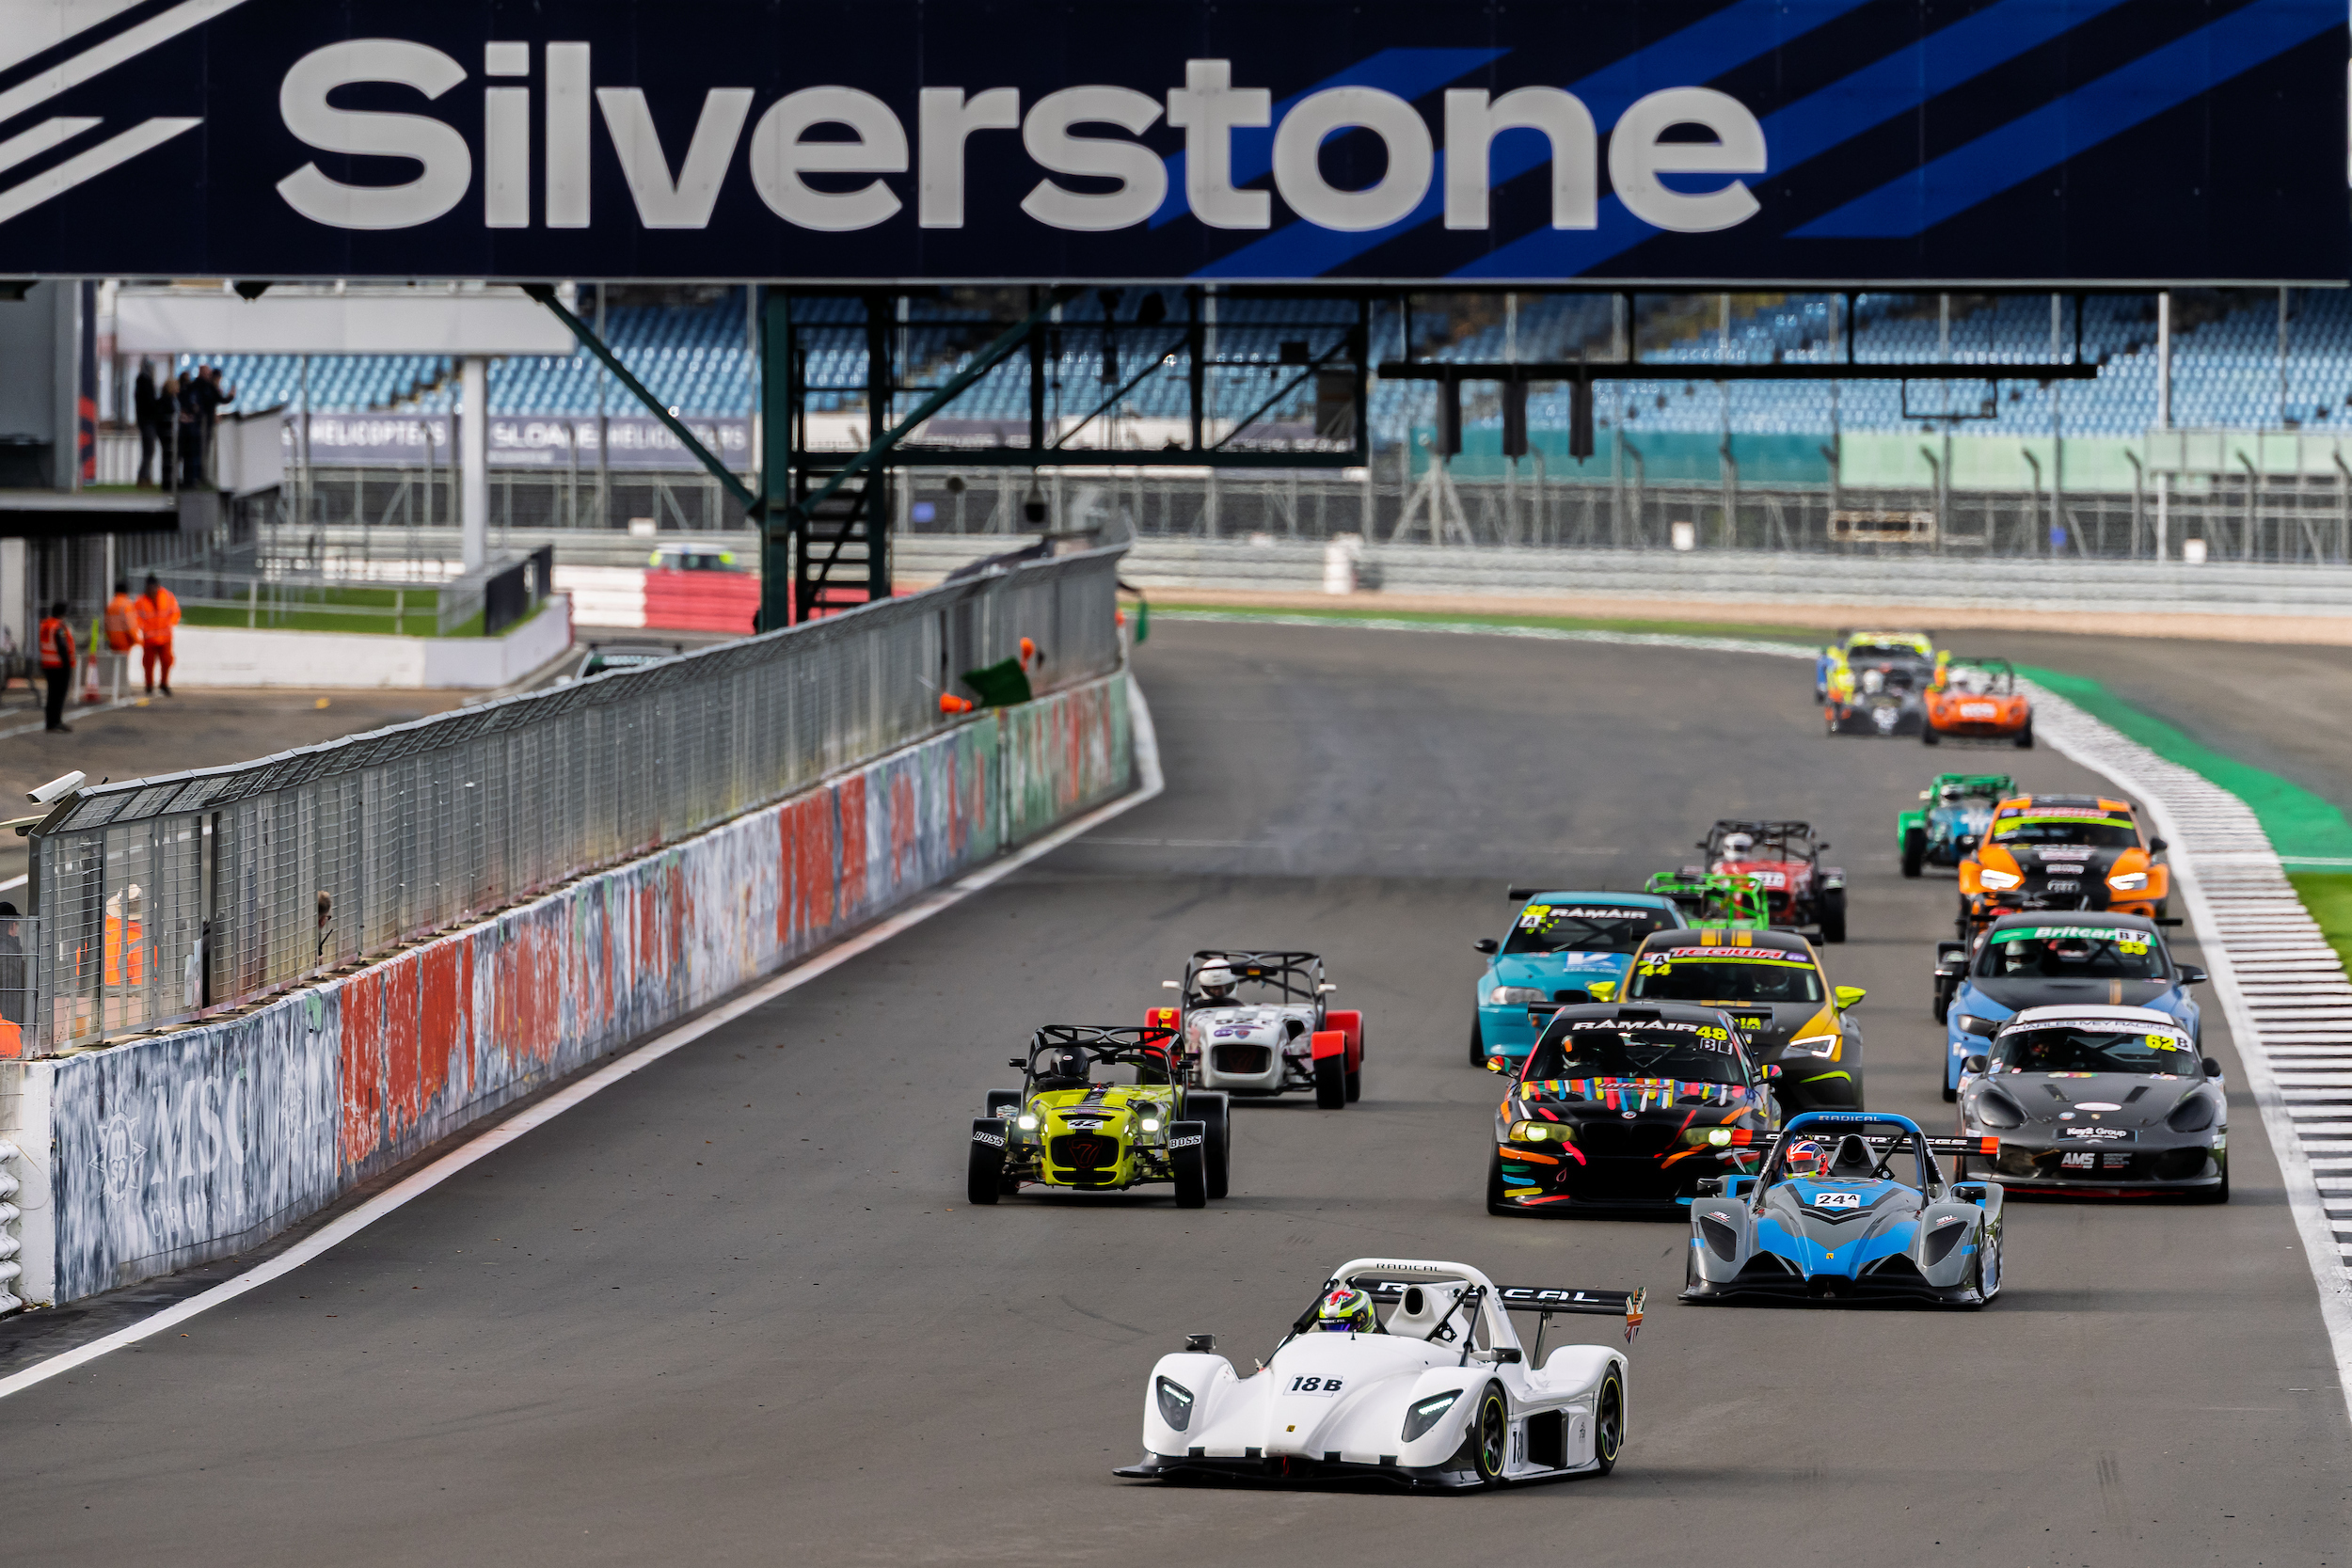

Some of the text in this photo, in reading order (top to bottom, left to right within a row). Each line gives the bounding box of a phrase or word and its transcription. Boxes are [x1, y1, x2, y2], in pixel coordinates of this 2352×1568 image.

[277, 39, 1768, 232] Silverstone
[310, 420, 446, 447] HELICOPTES
[1549, 908, 1648, 919] RAMAIR
[2034, 927, 2116, 939] Britcar
[1671, 947, 1785, 960] TEGIWA
[2119, 940, 2149, 956] 33
[1638, 963, 1672, 976] 44
[1572, 1019, 1728, 1040] RAMAIR 48
[2145, 1035, 2177, 1052] 62
[973, 1131, 1007, 1148] BOSS
[2095, 1128, 2127, 1138] Group
[1169, 1134, 1202, 1148] BOSS
[1376, 1262, 1442, 1273] RADICAL
[1377, 1281, 1599, 1303] RCAL
